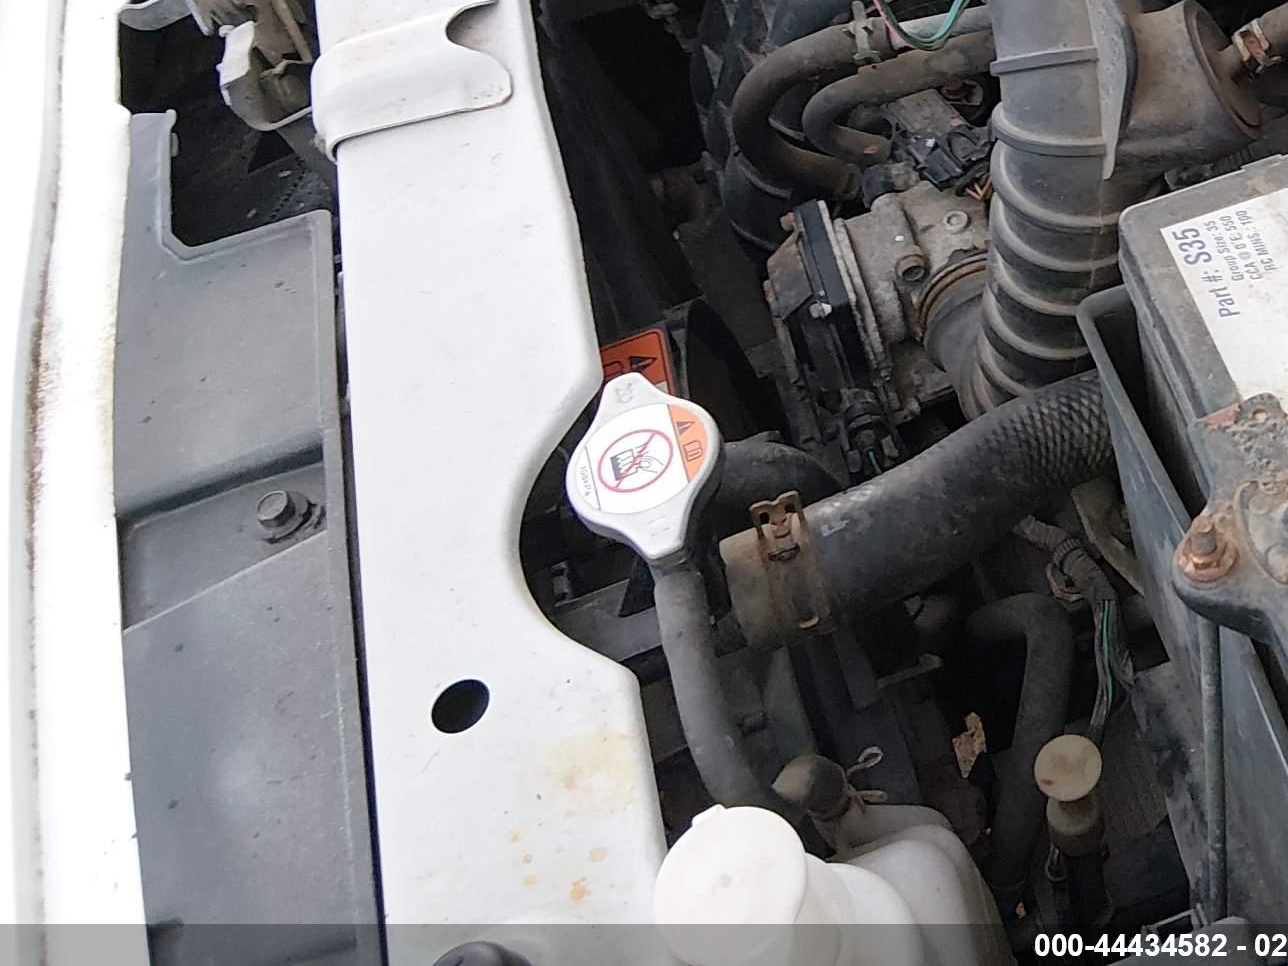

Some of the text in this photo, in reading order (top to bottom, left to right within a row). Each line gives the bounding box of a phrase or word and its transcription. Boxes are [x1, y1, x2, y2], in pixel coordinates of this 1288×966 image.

[1203, 220, 1219, 232] 35
[1219, 215, 1238, 232] 550
[1235, 210, 1254, 226] 100
[1171, 227, 1241, 317] Part #: S35
[1223, 255, 1245, 282] Group
[1243, 261, 1263, 281] CCA
[1259, 257, 1278, 272] RC
